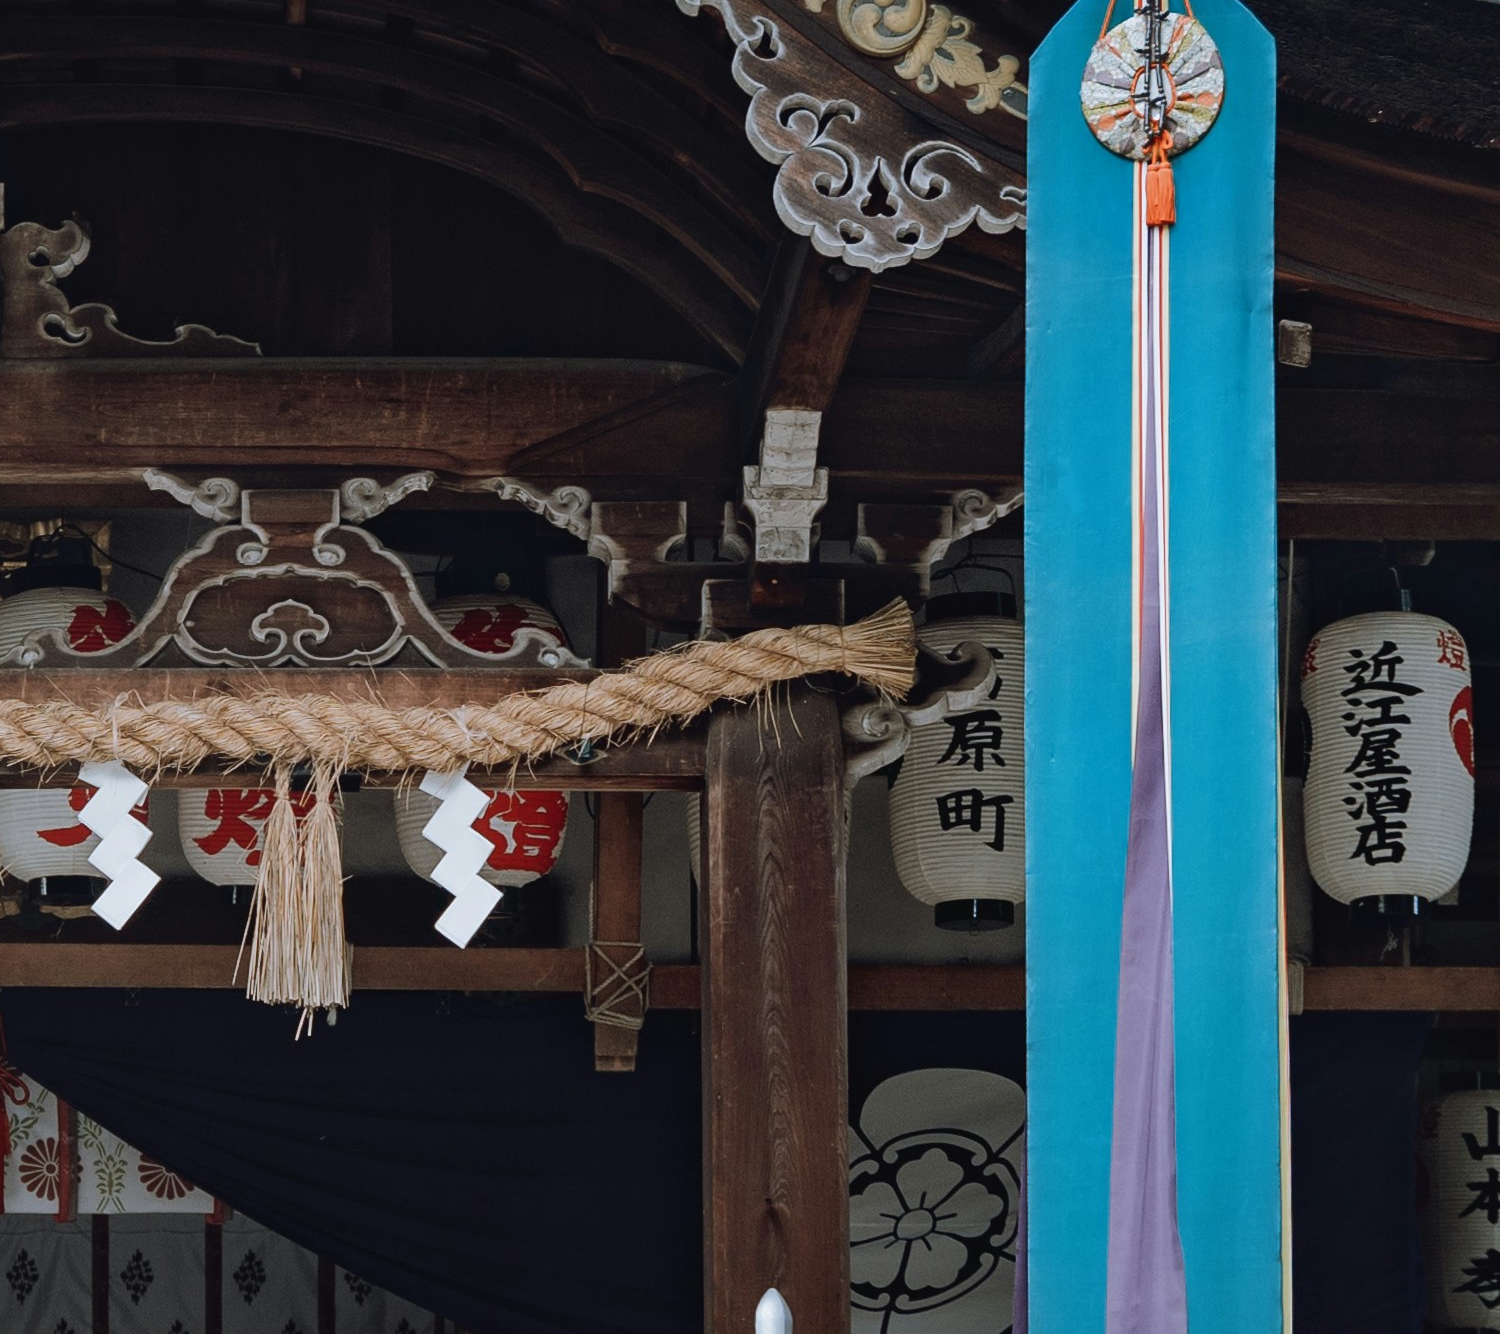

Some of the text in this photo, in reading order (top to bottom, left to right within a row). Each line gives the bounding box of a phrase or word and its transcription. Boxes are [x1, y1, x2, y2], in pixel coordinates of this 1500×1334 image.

[936, 647, 1014, 852] 原町
[1340, 640, 1424, 867] 近江屋酒店
